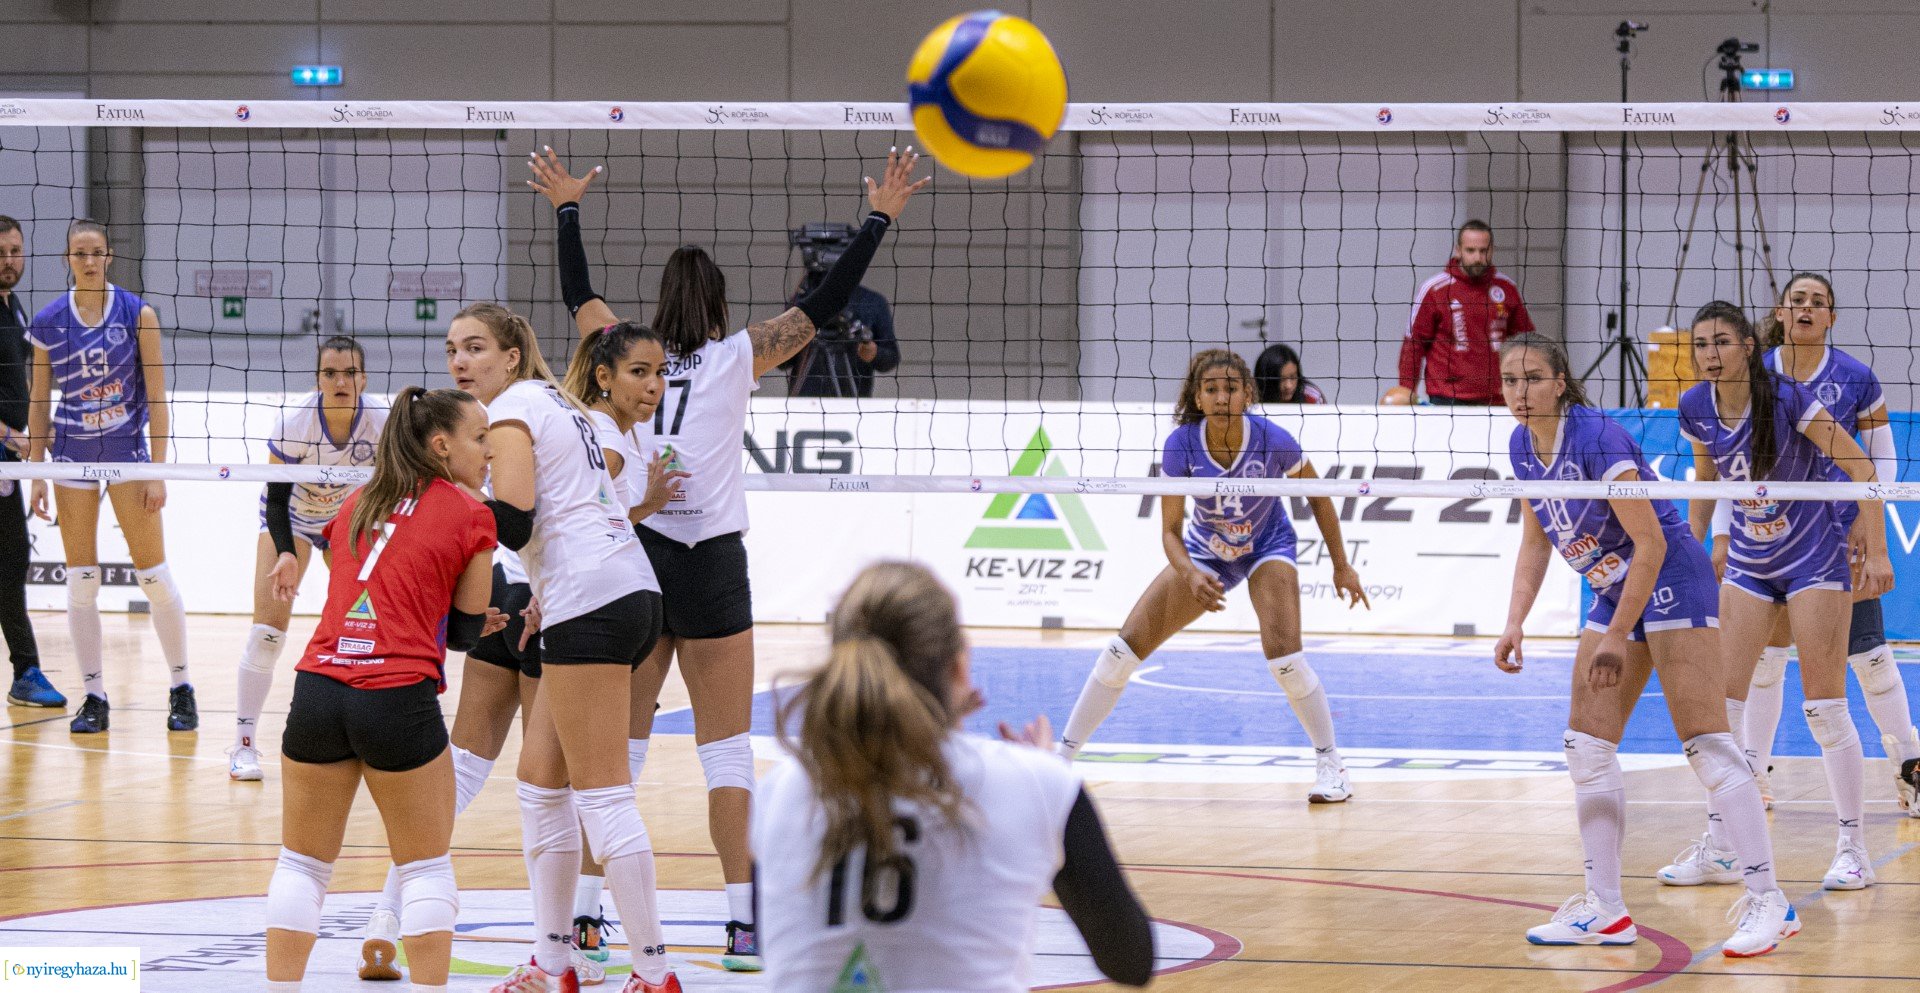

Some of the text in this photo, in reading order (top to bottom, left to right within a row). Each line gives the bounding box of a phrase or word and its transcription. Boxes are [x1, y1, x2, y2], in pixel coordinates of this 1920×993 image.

[95, 104, 145, 119] FATUM
[465, 106, 515, 122] FATUM
[843, 107, 895, 122] FATUM
[1229, 107, 1282, 123] FATUM
[1622, 107, 1675, 123] FATUM
[78, 348, 110, 378] 13
[654, 379, 692, 435] 17
[572, 414, 606, 470] 13
[81, 465, 122, 478] FATUM
[829, 477, 870, 492] FATUM
[1214, 481, 1256, 494] FATUM
[1607, 484, 1650, 496] FATUM
[357, 522, 397, 581] 7
[965, 556, 1104, 580] KE-VIZ 21
[1652, 586, 1675, 606] 10
[827, 816, 917, 928] 16
